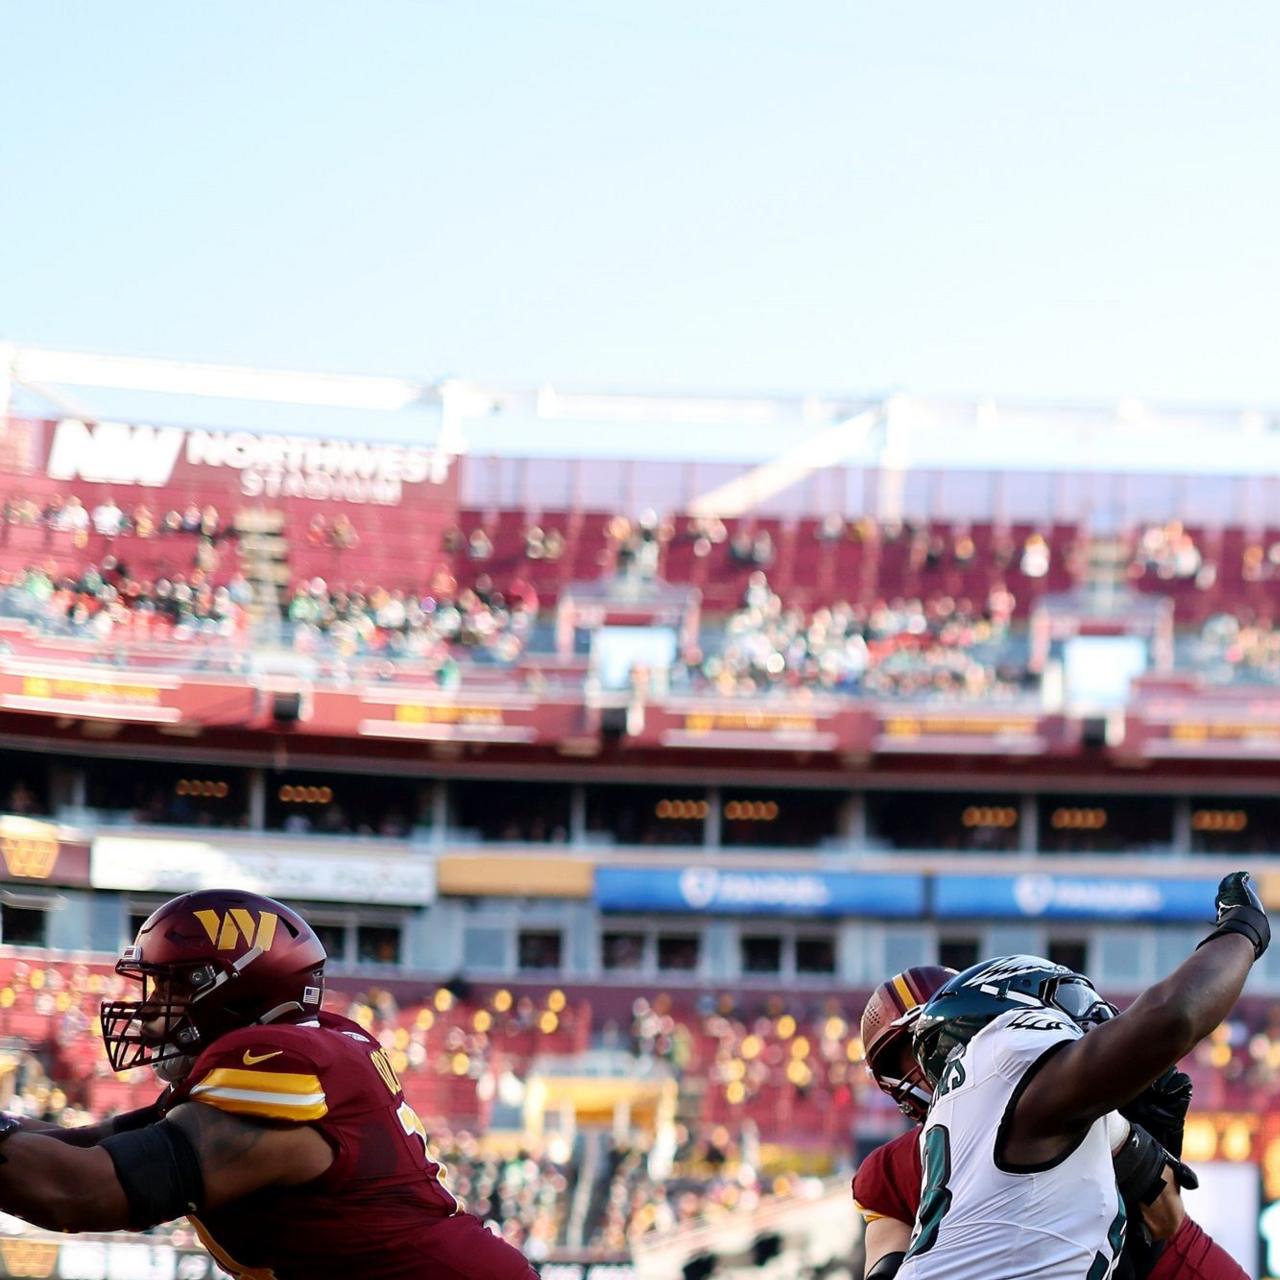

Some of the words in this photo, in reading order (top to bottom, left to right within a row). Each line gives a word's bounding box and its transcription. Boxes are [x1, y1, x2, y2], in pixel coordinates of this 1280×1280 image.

[48, 420, 186, 487] NW
[186, 430, 458, 485] NORTHWEST
[239, 466, 402, 506] STADIUM
